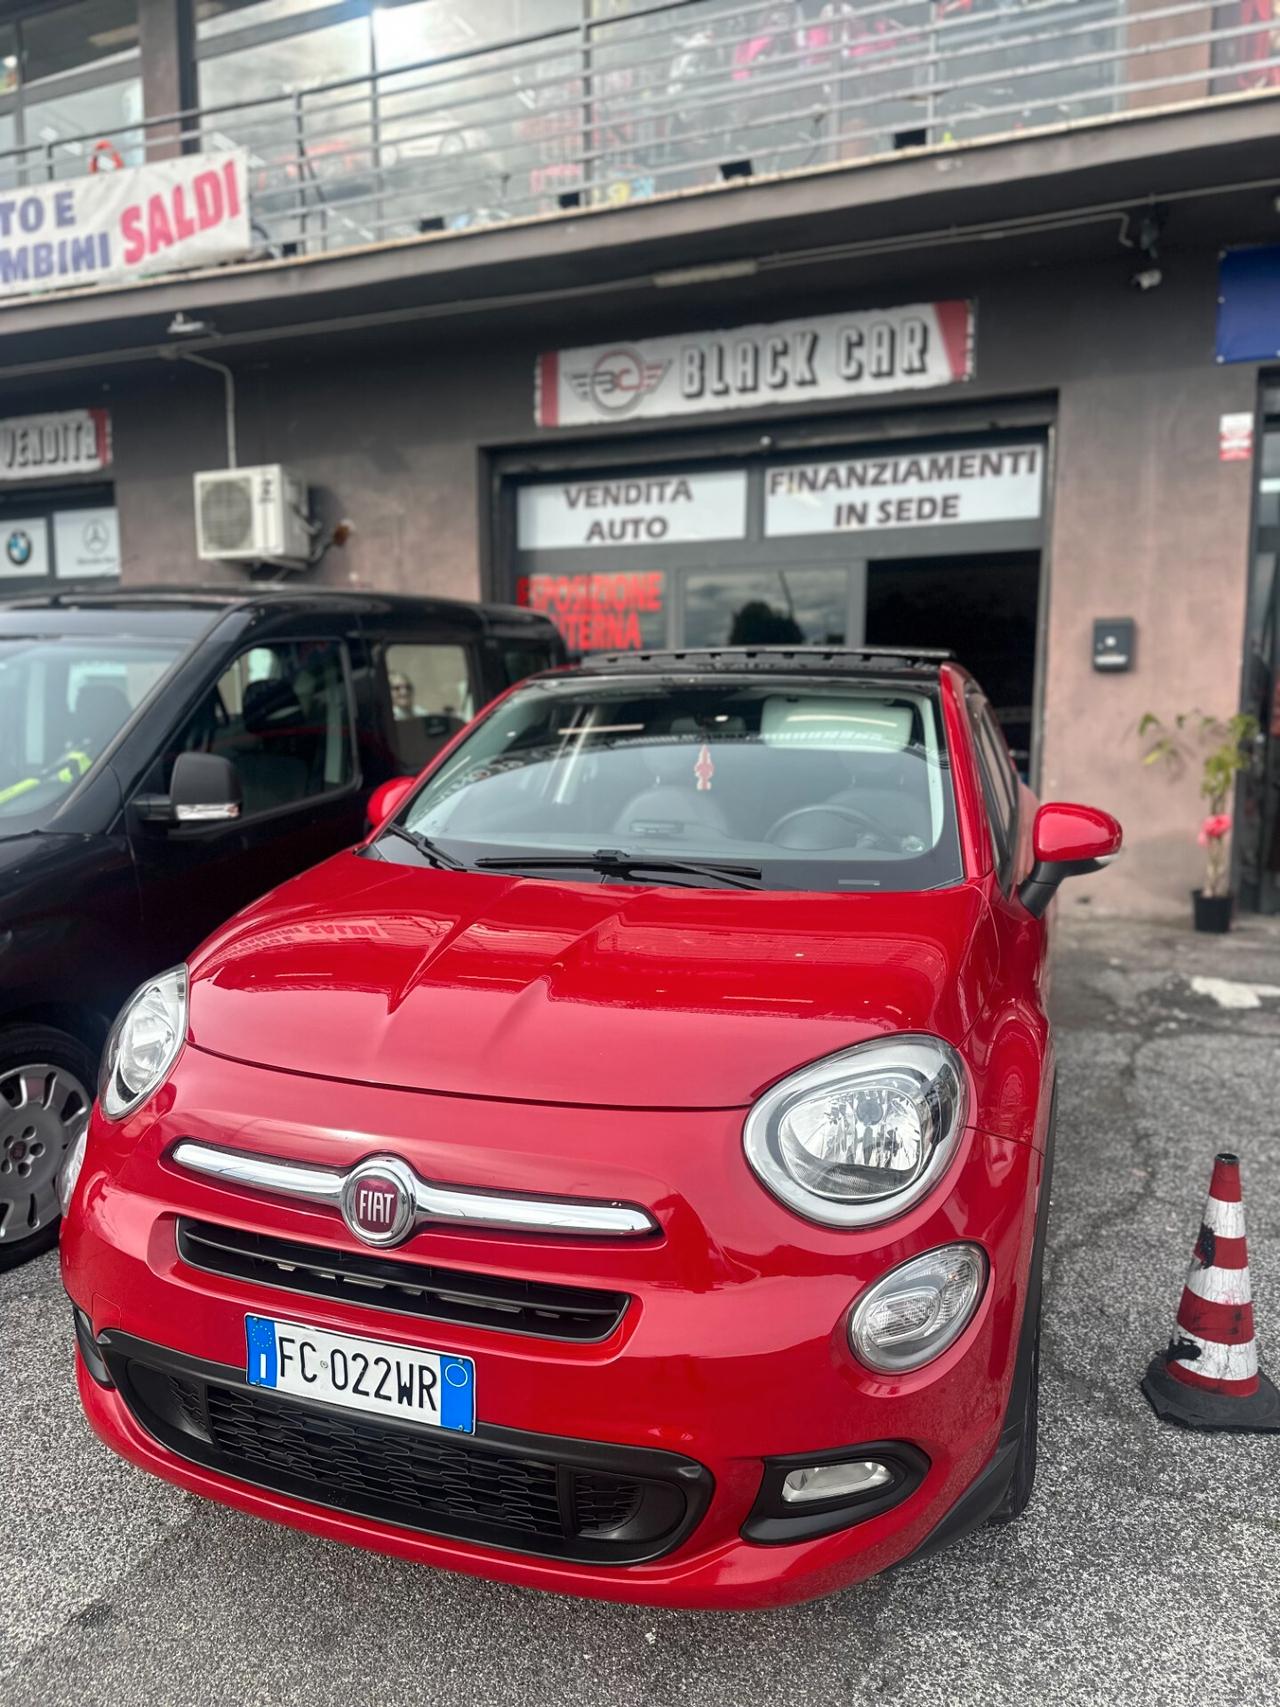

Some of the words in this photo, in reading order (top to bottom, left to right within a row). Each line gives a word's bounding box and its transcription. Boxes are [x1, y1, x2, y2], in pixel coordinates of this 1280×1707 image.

[54, 191, 75, 228] E
[119, 159, 240, 265] SALDI
[680, 332, 818, 399] BLACK
[838, 318, 929, 381] CAR
[769, 450, 1038, 495] FINANZIAMENTI
[564, 478, 694, 509] VENDITA
[833, 502, 868, 527] IN
[877, 494, 960, 524] SEDE
[584, 516, 668, 543] AUTO
[360, 1189, 395, 1224] FIAT
[278, 1336, 318, 1383] FC
[330, 1348, 438, 1411] 022WR
